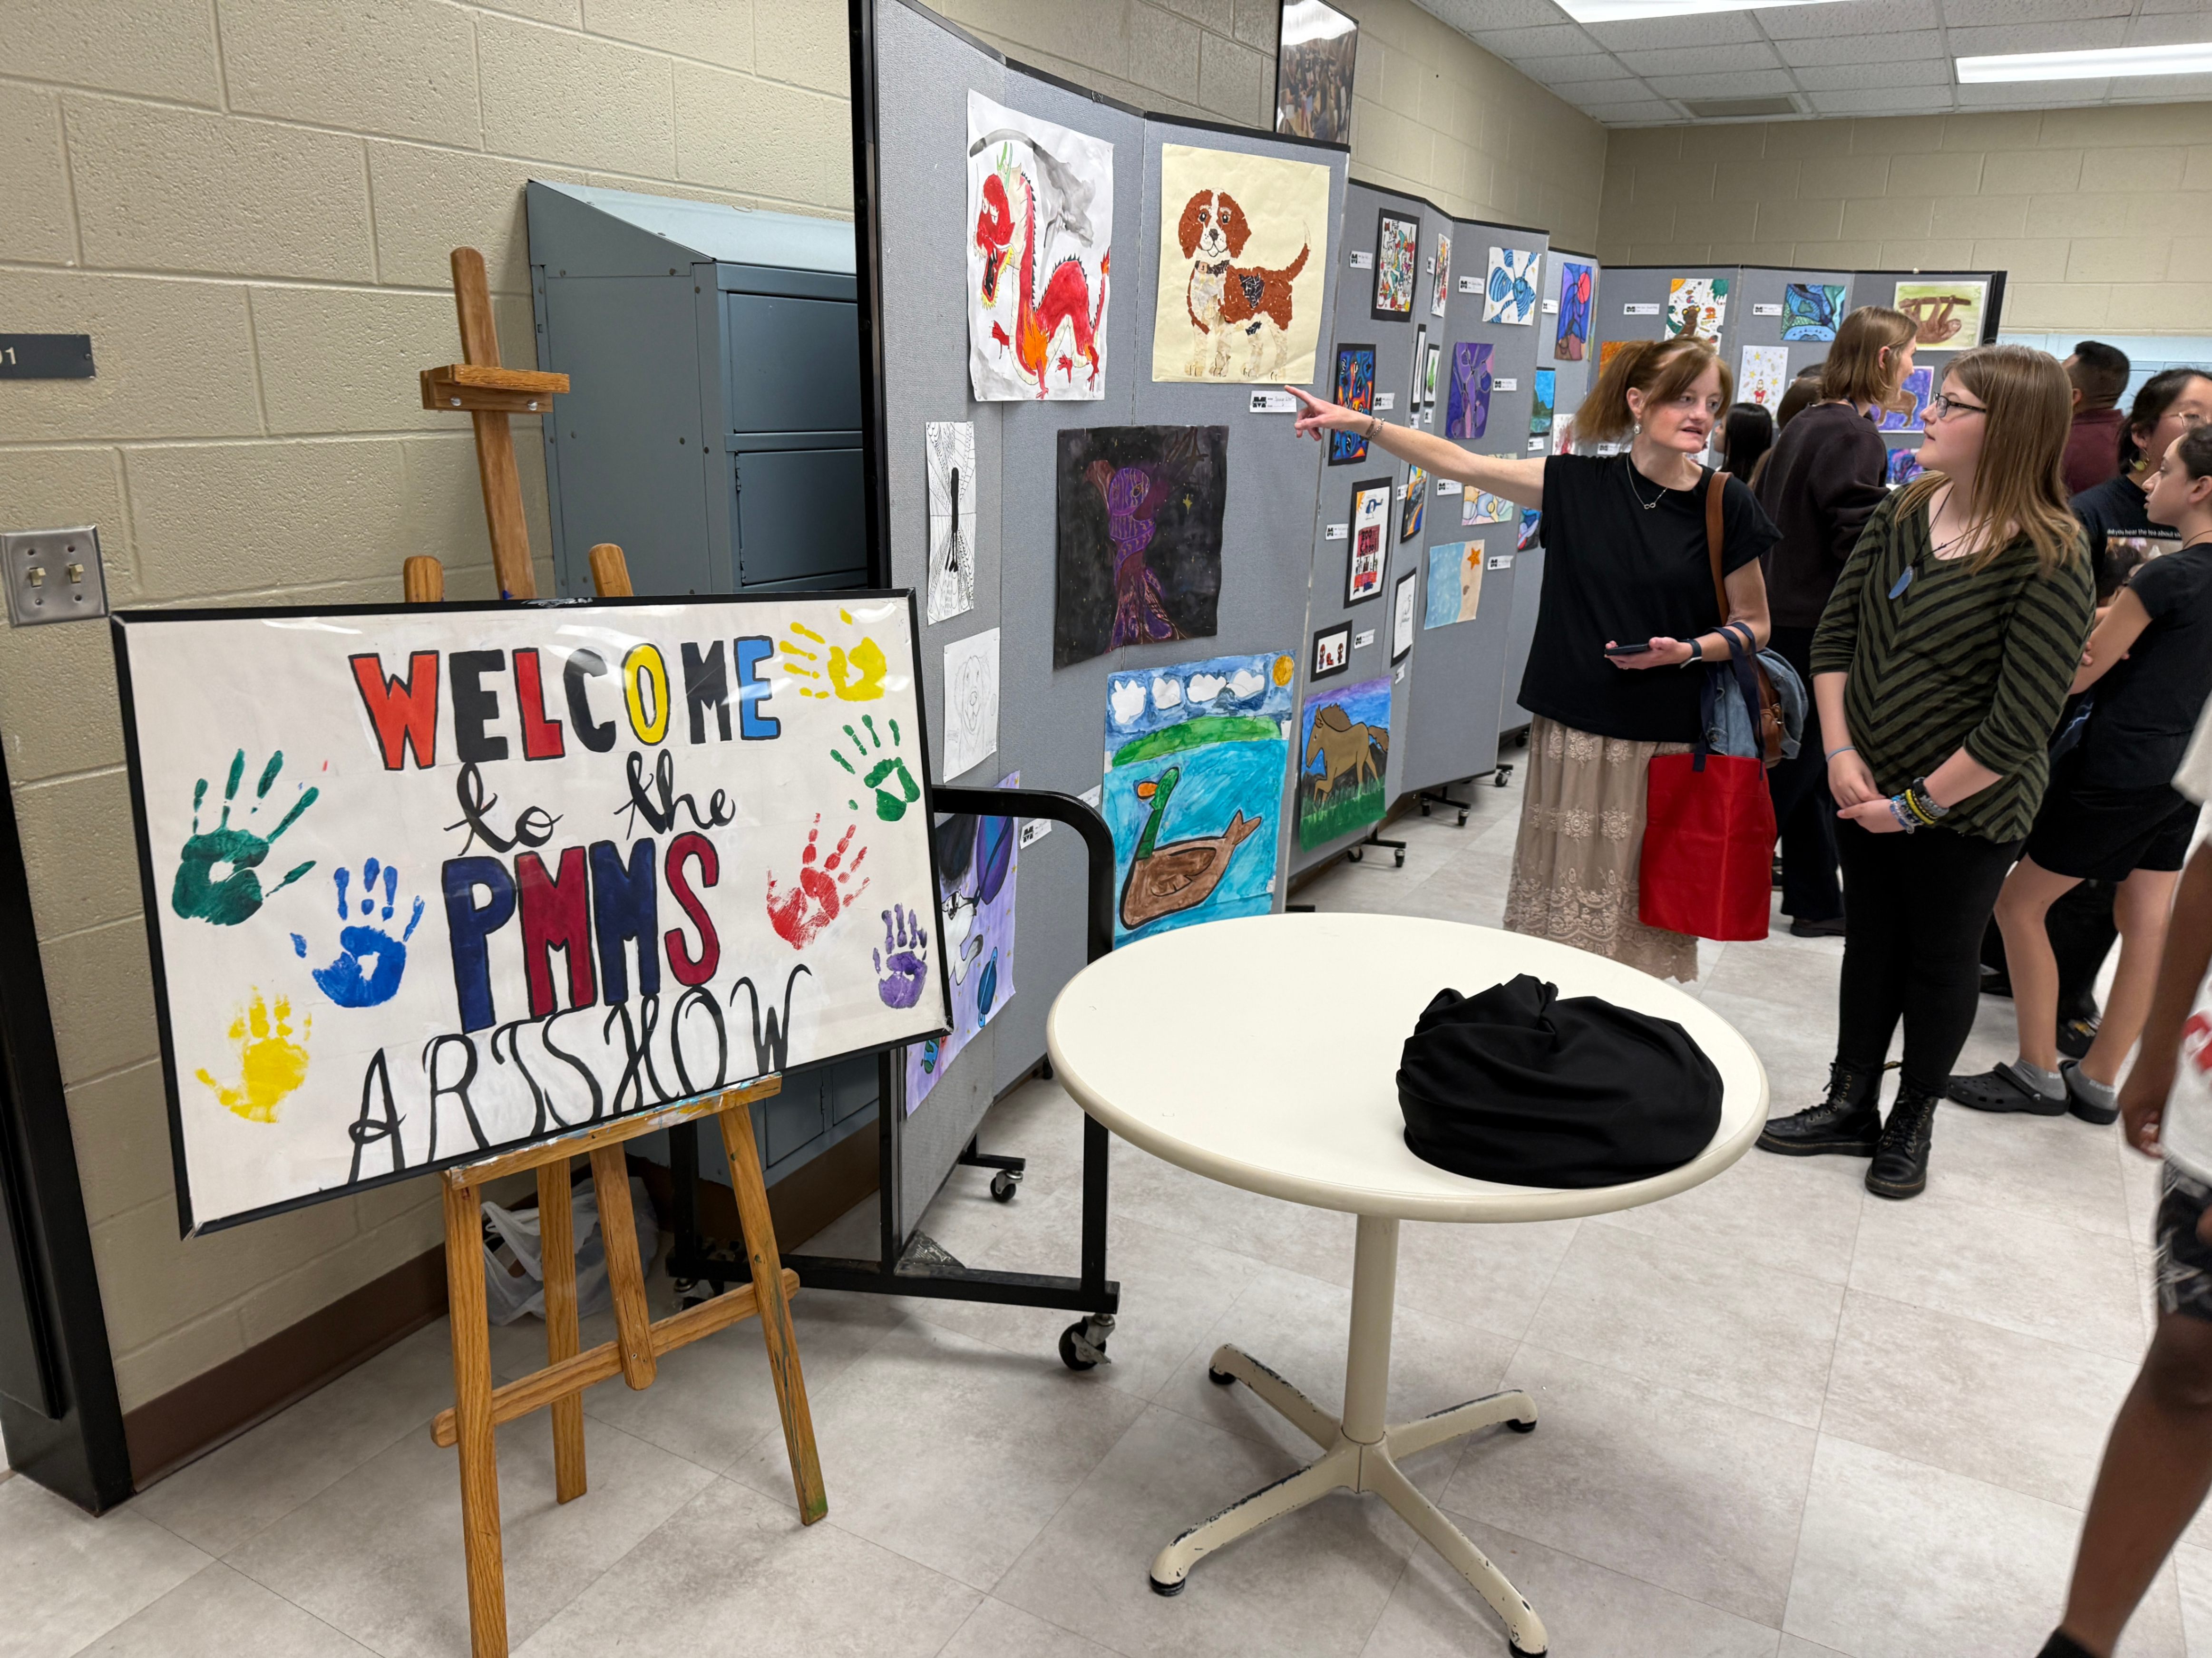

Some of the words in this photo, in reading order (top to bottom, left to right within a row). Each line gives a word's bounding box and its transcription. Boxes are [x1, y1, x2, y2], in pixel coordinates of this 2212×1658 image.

[0, 347, 16, 365] 1
[2157, 530, 2173, 538] about
[348, 635, 781, 770] WELCOME
[443, 761, 564, 856] to
[614, 748, 736, 841] the
[441, 832, 720, 1034] PMMS
